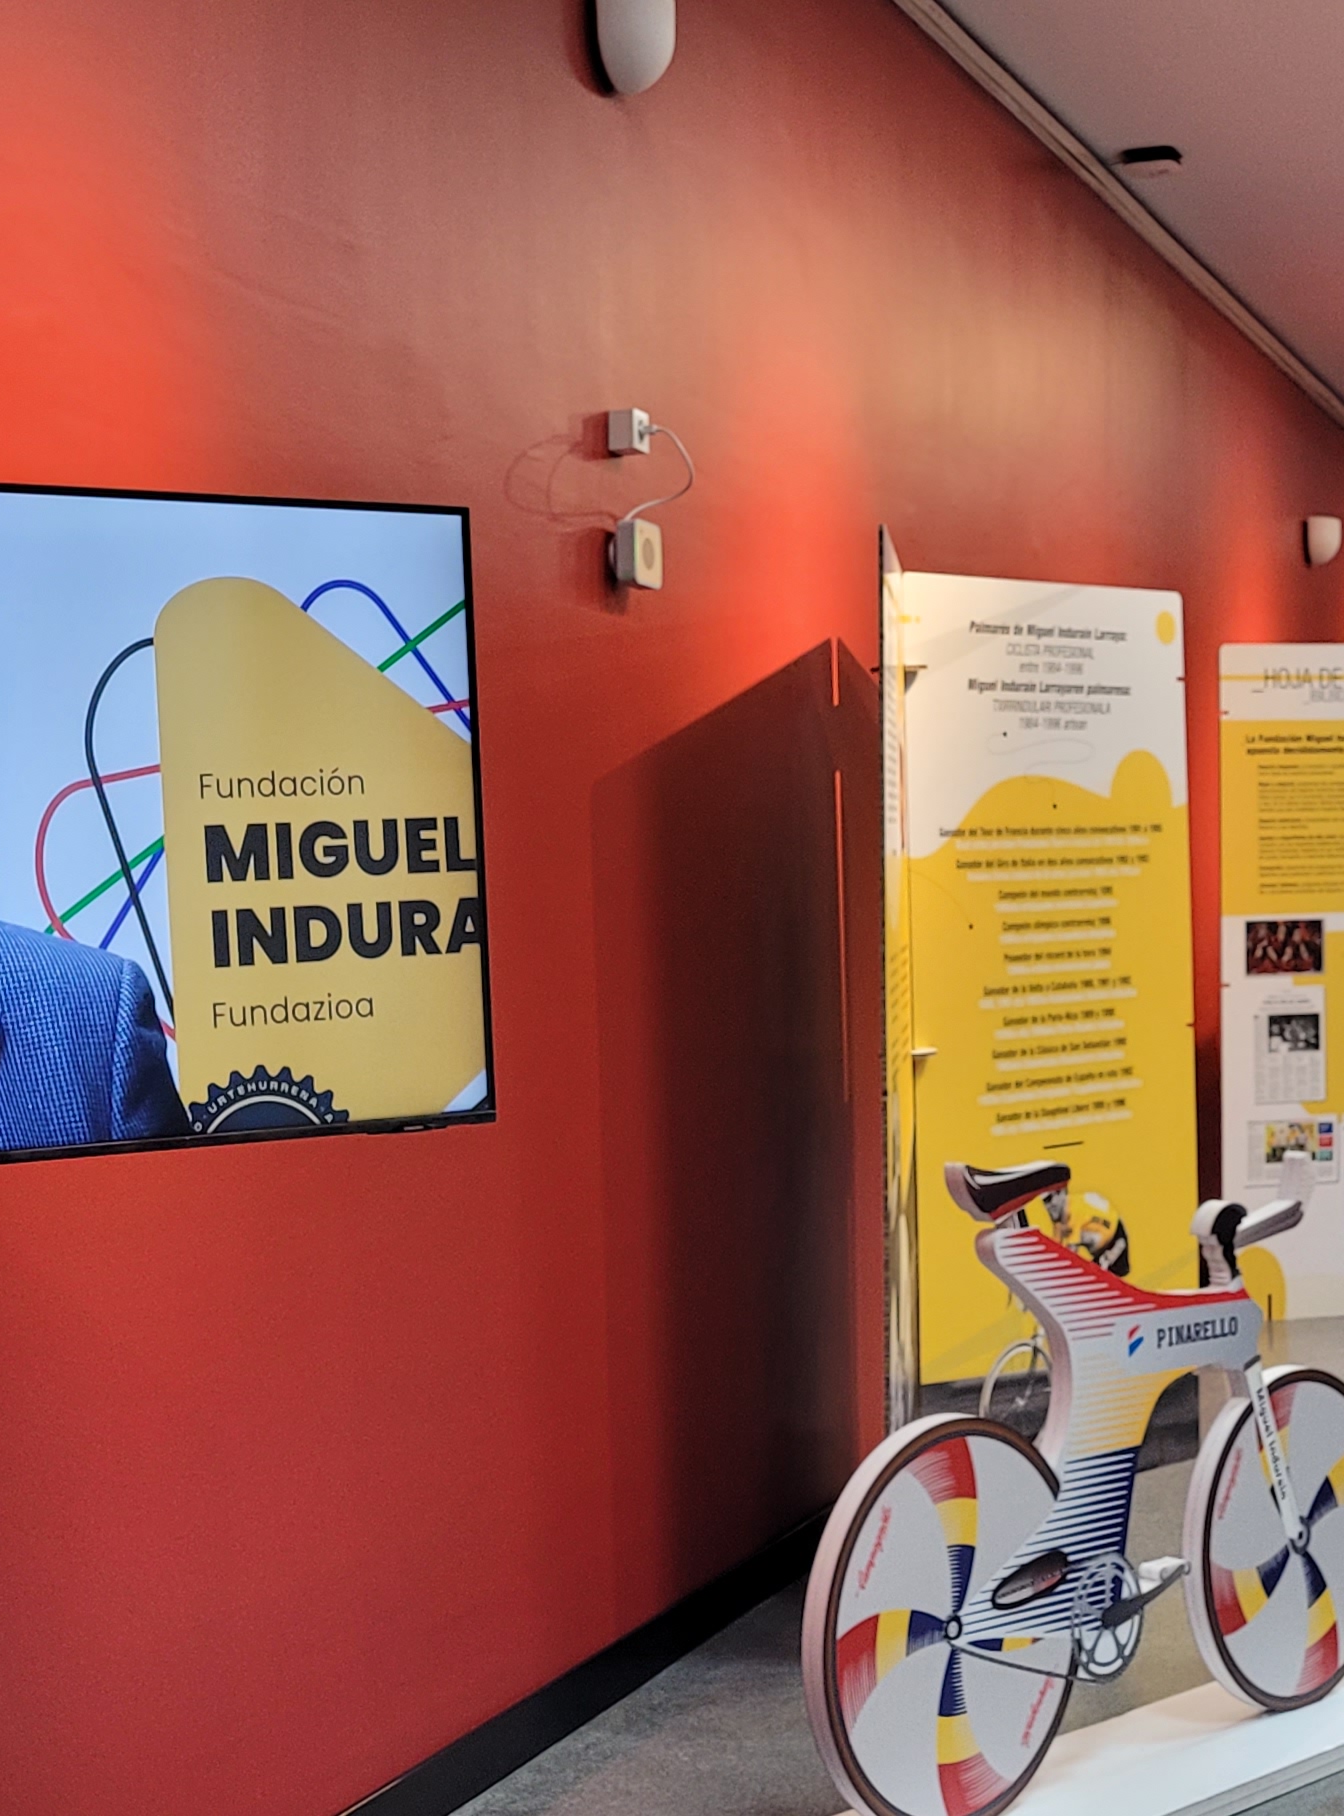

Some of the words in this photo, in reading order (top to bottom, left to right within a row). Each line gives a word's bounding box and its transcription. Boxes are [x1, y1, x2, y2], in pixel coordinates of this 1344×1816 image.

[1318, 668, 1343, 689] DE
[199, 768, 366, 799] Fundación
[204, 816, 478, 883] MIGUEL
[210, 897, 482, 968] INDURA
[212, 992, 374, 1028] Fundazioa
[1157, 1316, 1238, 1349] PINARELLO
